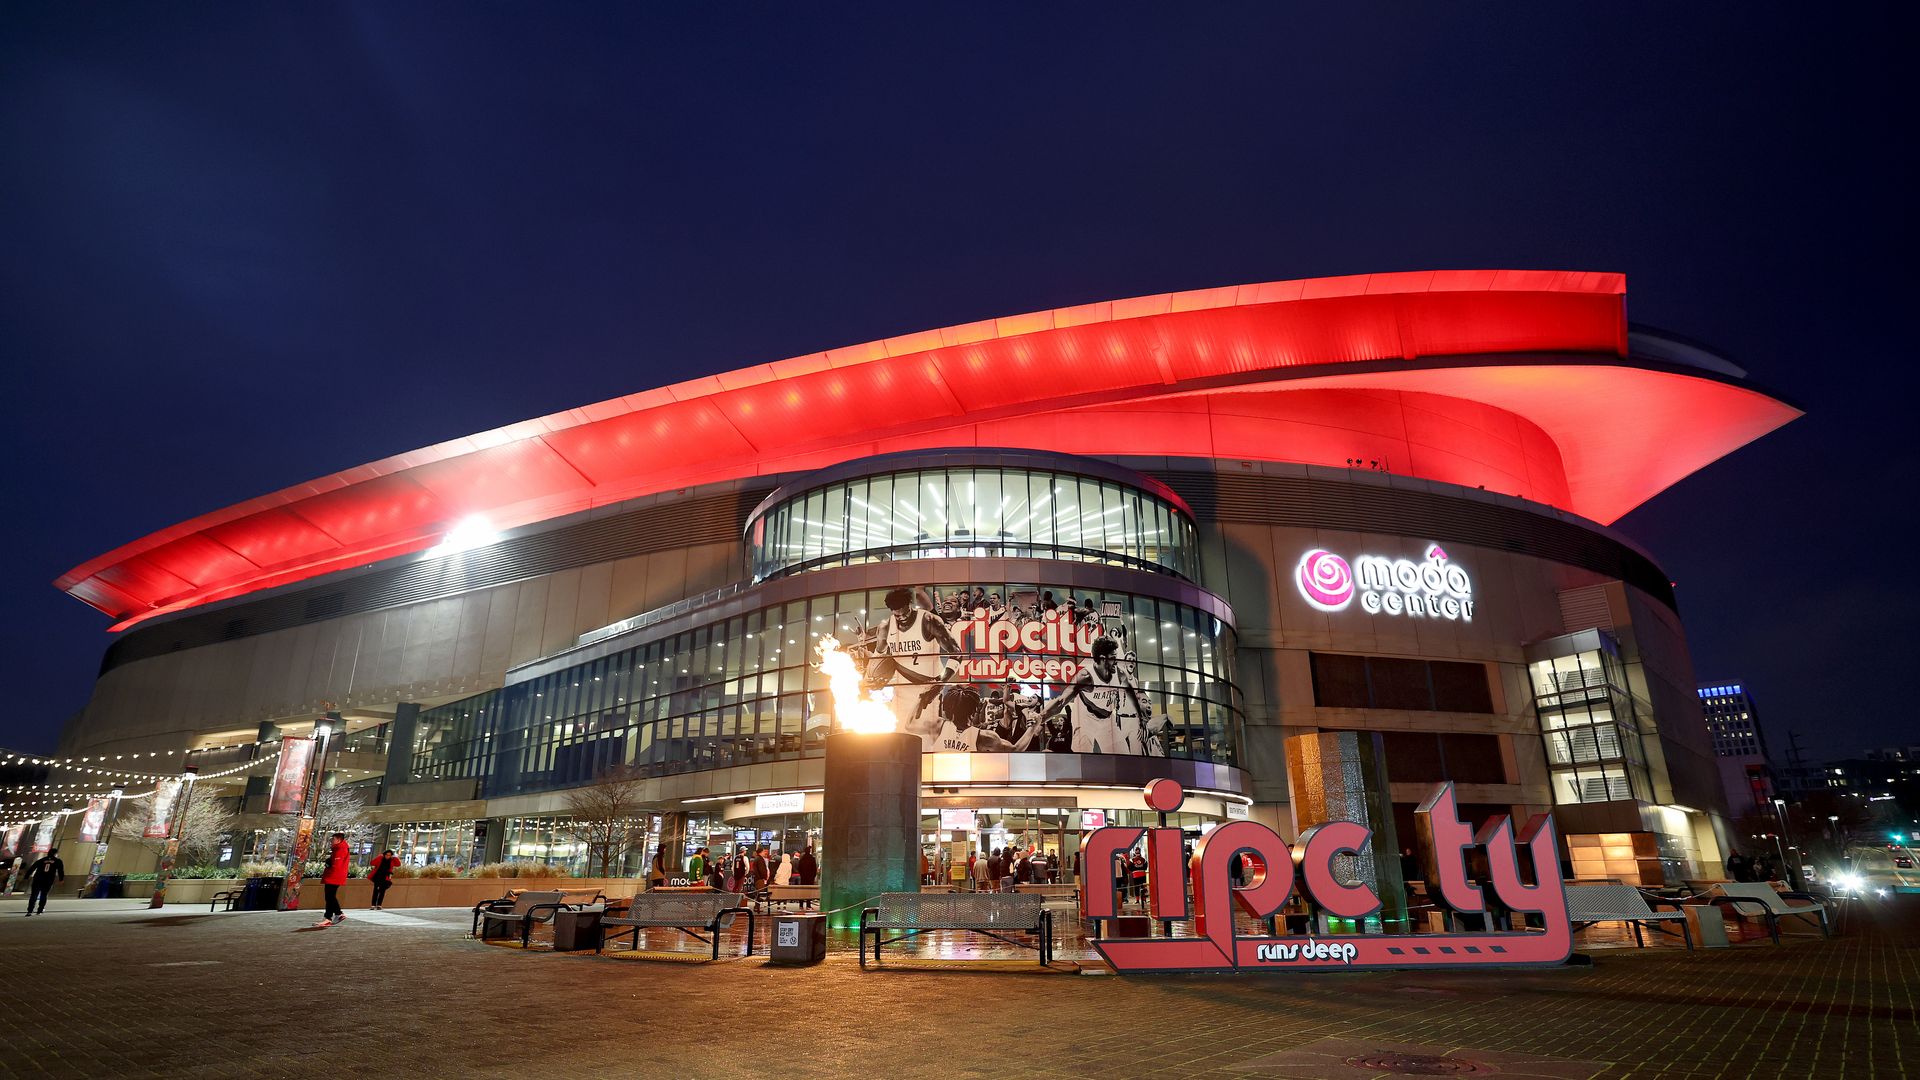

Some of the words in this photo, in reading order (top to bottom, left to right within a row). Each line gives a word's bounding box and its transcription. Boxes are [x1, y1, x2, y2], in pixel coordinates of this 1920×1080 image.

[1356, 543, 1473, 597] moda
[1101, 602, 1121, 617] LOUDER
[1360, 590, 1474, 622] center
[889, 639, 922, 653] BLAZERS
[911, 652, 920, 666] 2
[958, 657, 1010, 679] runs
[1013, 654, 1078, 684] deep
[1257, 943, 1299, 961] runs
[1301, 937, 1358, 965] deep
